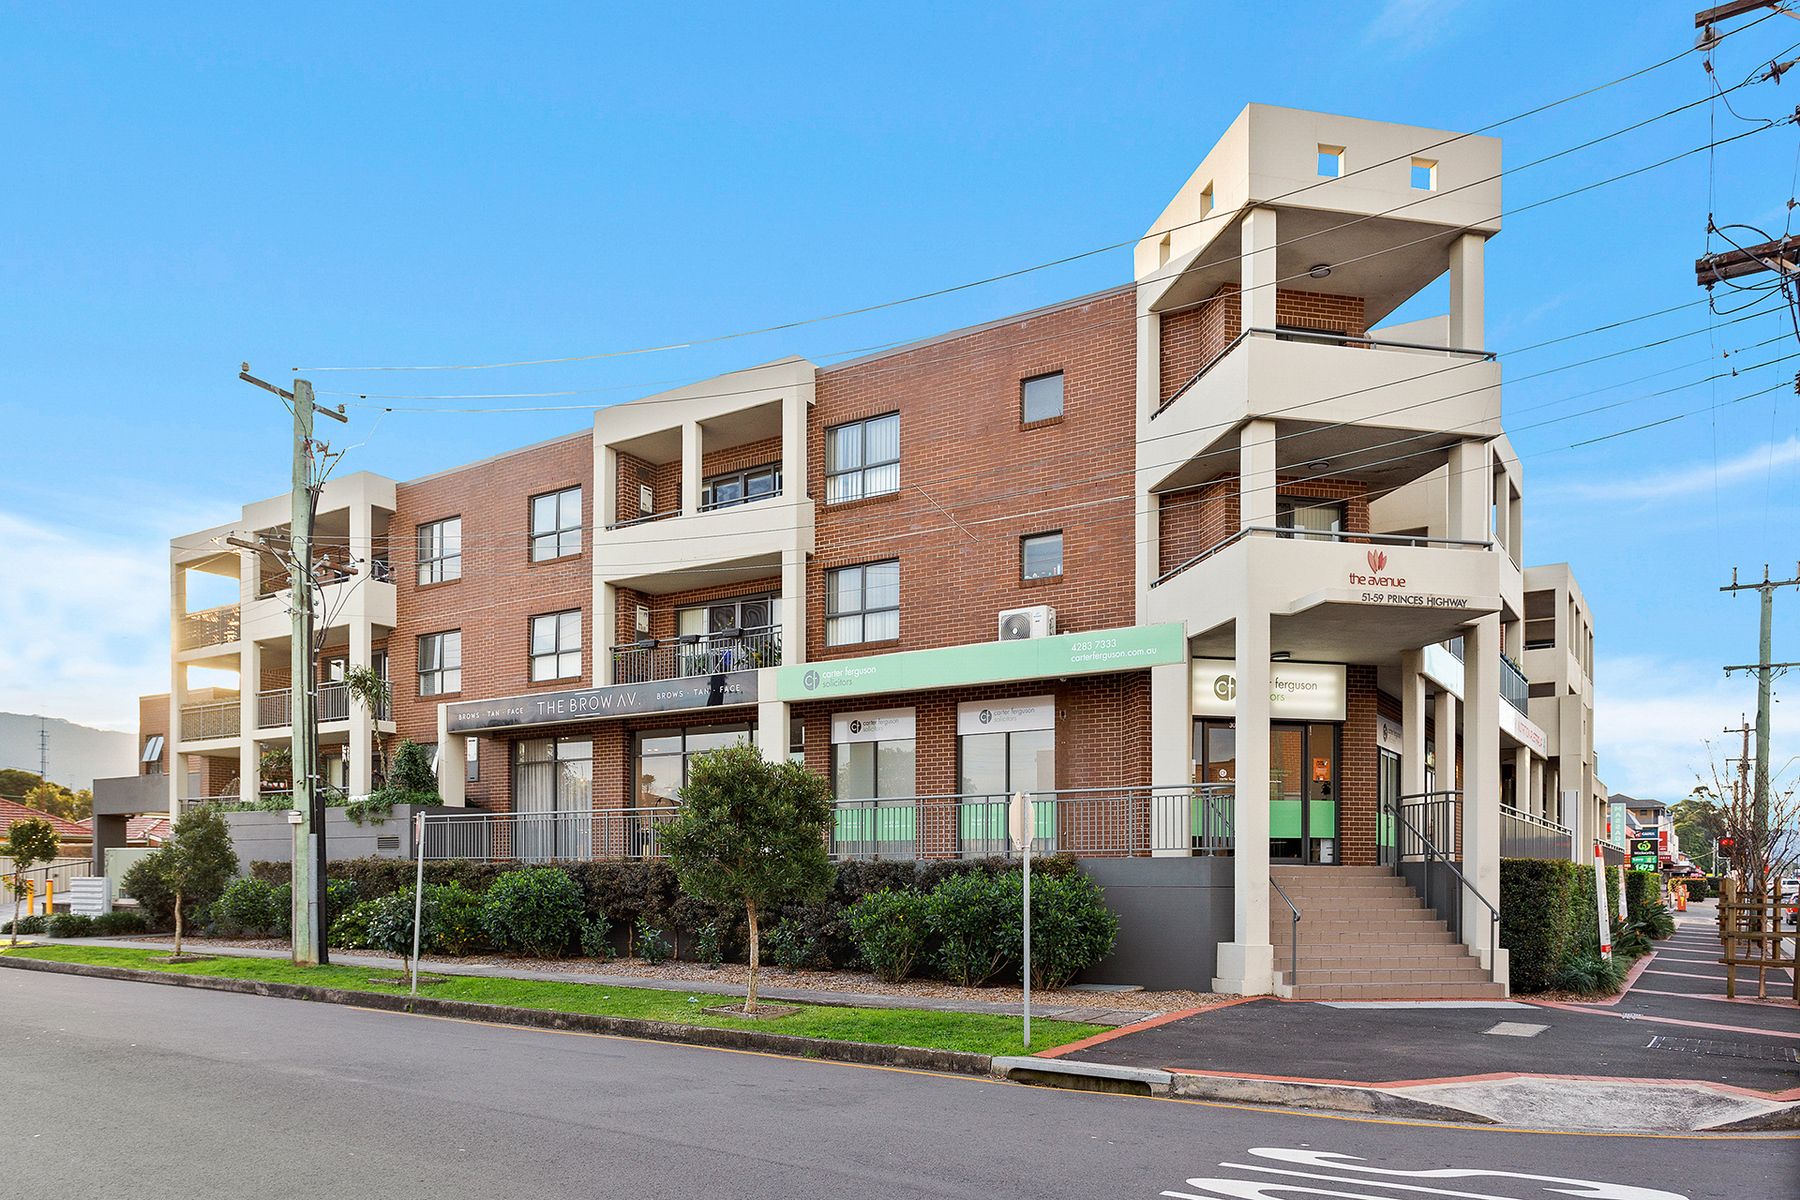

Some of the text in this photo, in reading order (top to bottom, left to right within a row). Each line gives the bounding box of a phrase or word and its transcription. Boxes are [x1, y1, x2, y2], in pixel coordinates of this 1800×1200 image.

[1349, 573, 1406, 588] the avenue
[1361, 592, 1468, 608] 51-59 PRINCES HIGHWAY
[1071, 638, 1117, 652] 4283 7333
[1071, 647, 1158, 662] carterferguson.com.au
[822, 666, 877, 679] carter ferguson
[822, 678, 853, 688] solicitors
[1275, 677, 1318, 693] ferguson
[656, 684, 741, 700] BROWS TAN FACE
[537, 699, 565, 715] THE
[569, 694, 612, 713] BROW
[458, 707, 524, 721] BROWS TAN FACE
